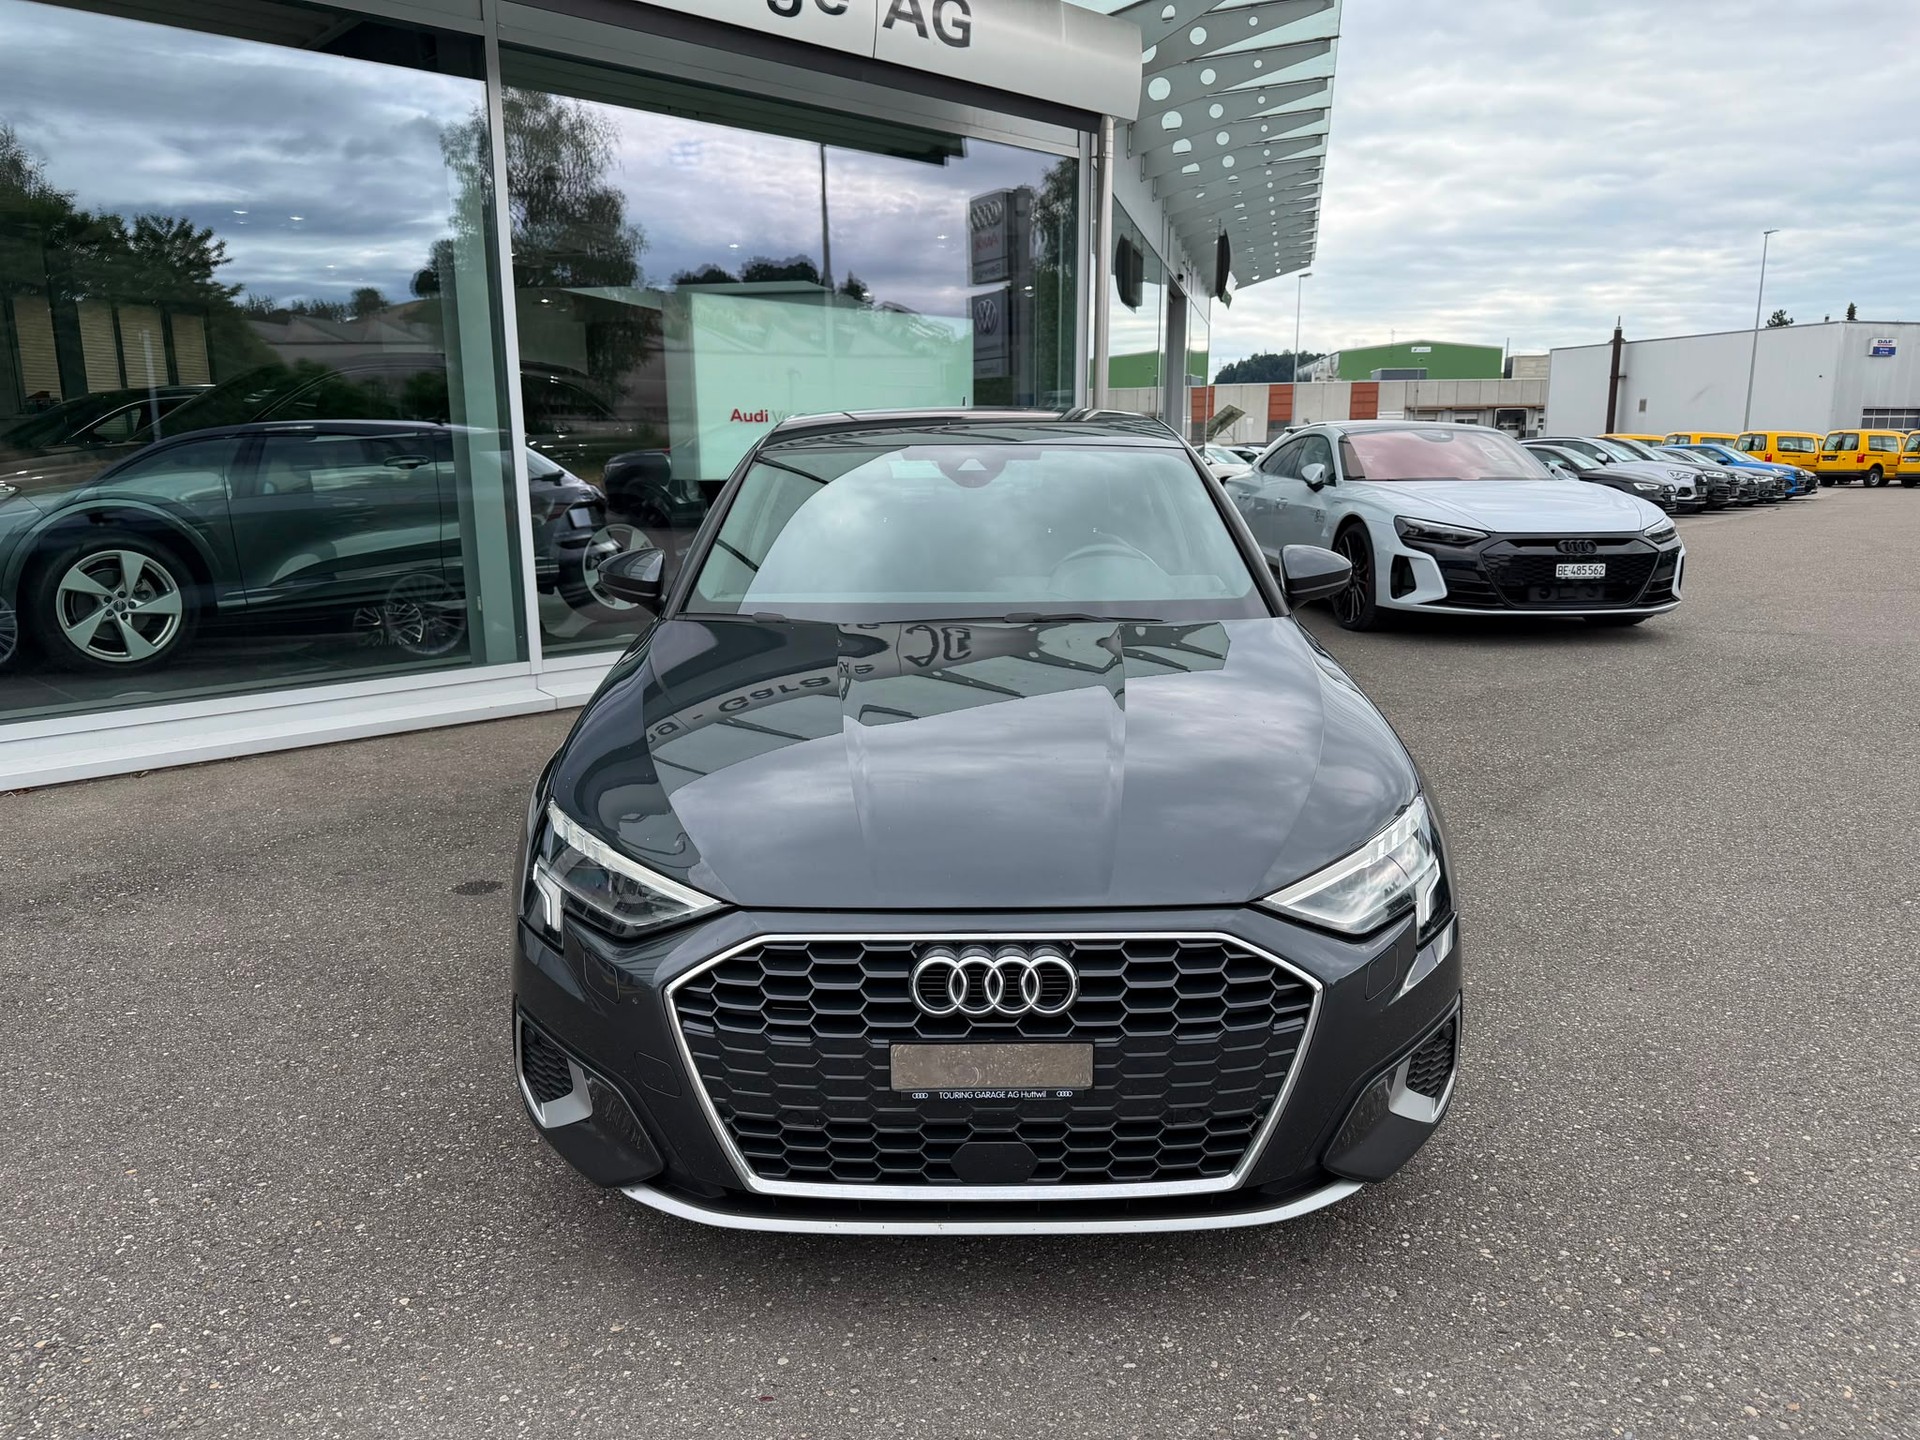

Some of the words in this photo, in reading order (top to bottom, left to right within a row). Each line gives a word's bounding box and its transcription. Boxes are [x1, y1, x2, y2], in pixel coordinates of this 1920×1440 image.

[882, 0, 972, 48] AG
[730, 408, 769, 422] Audi
[939, 1091, 973, 1099] TOURING
[974, 1091, 1005, 1099] GARAGE
[1007, 1090, 1020, 1099] AG
[1020, 1090, 1047, 1098] Huttwil
